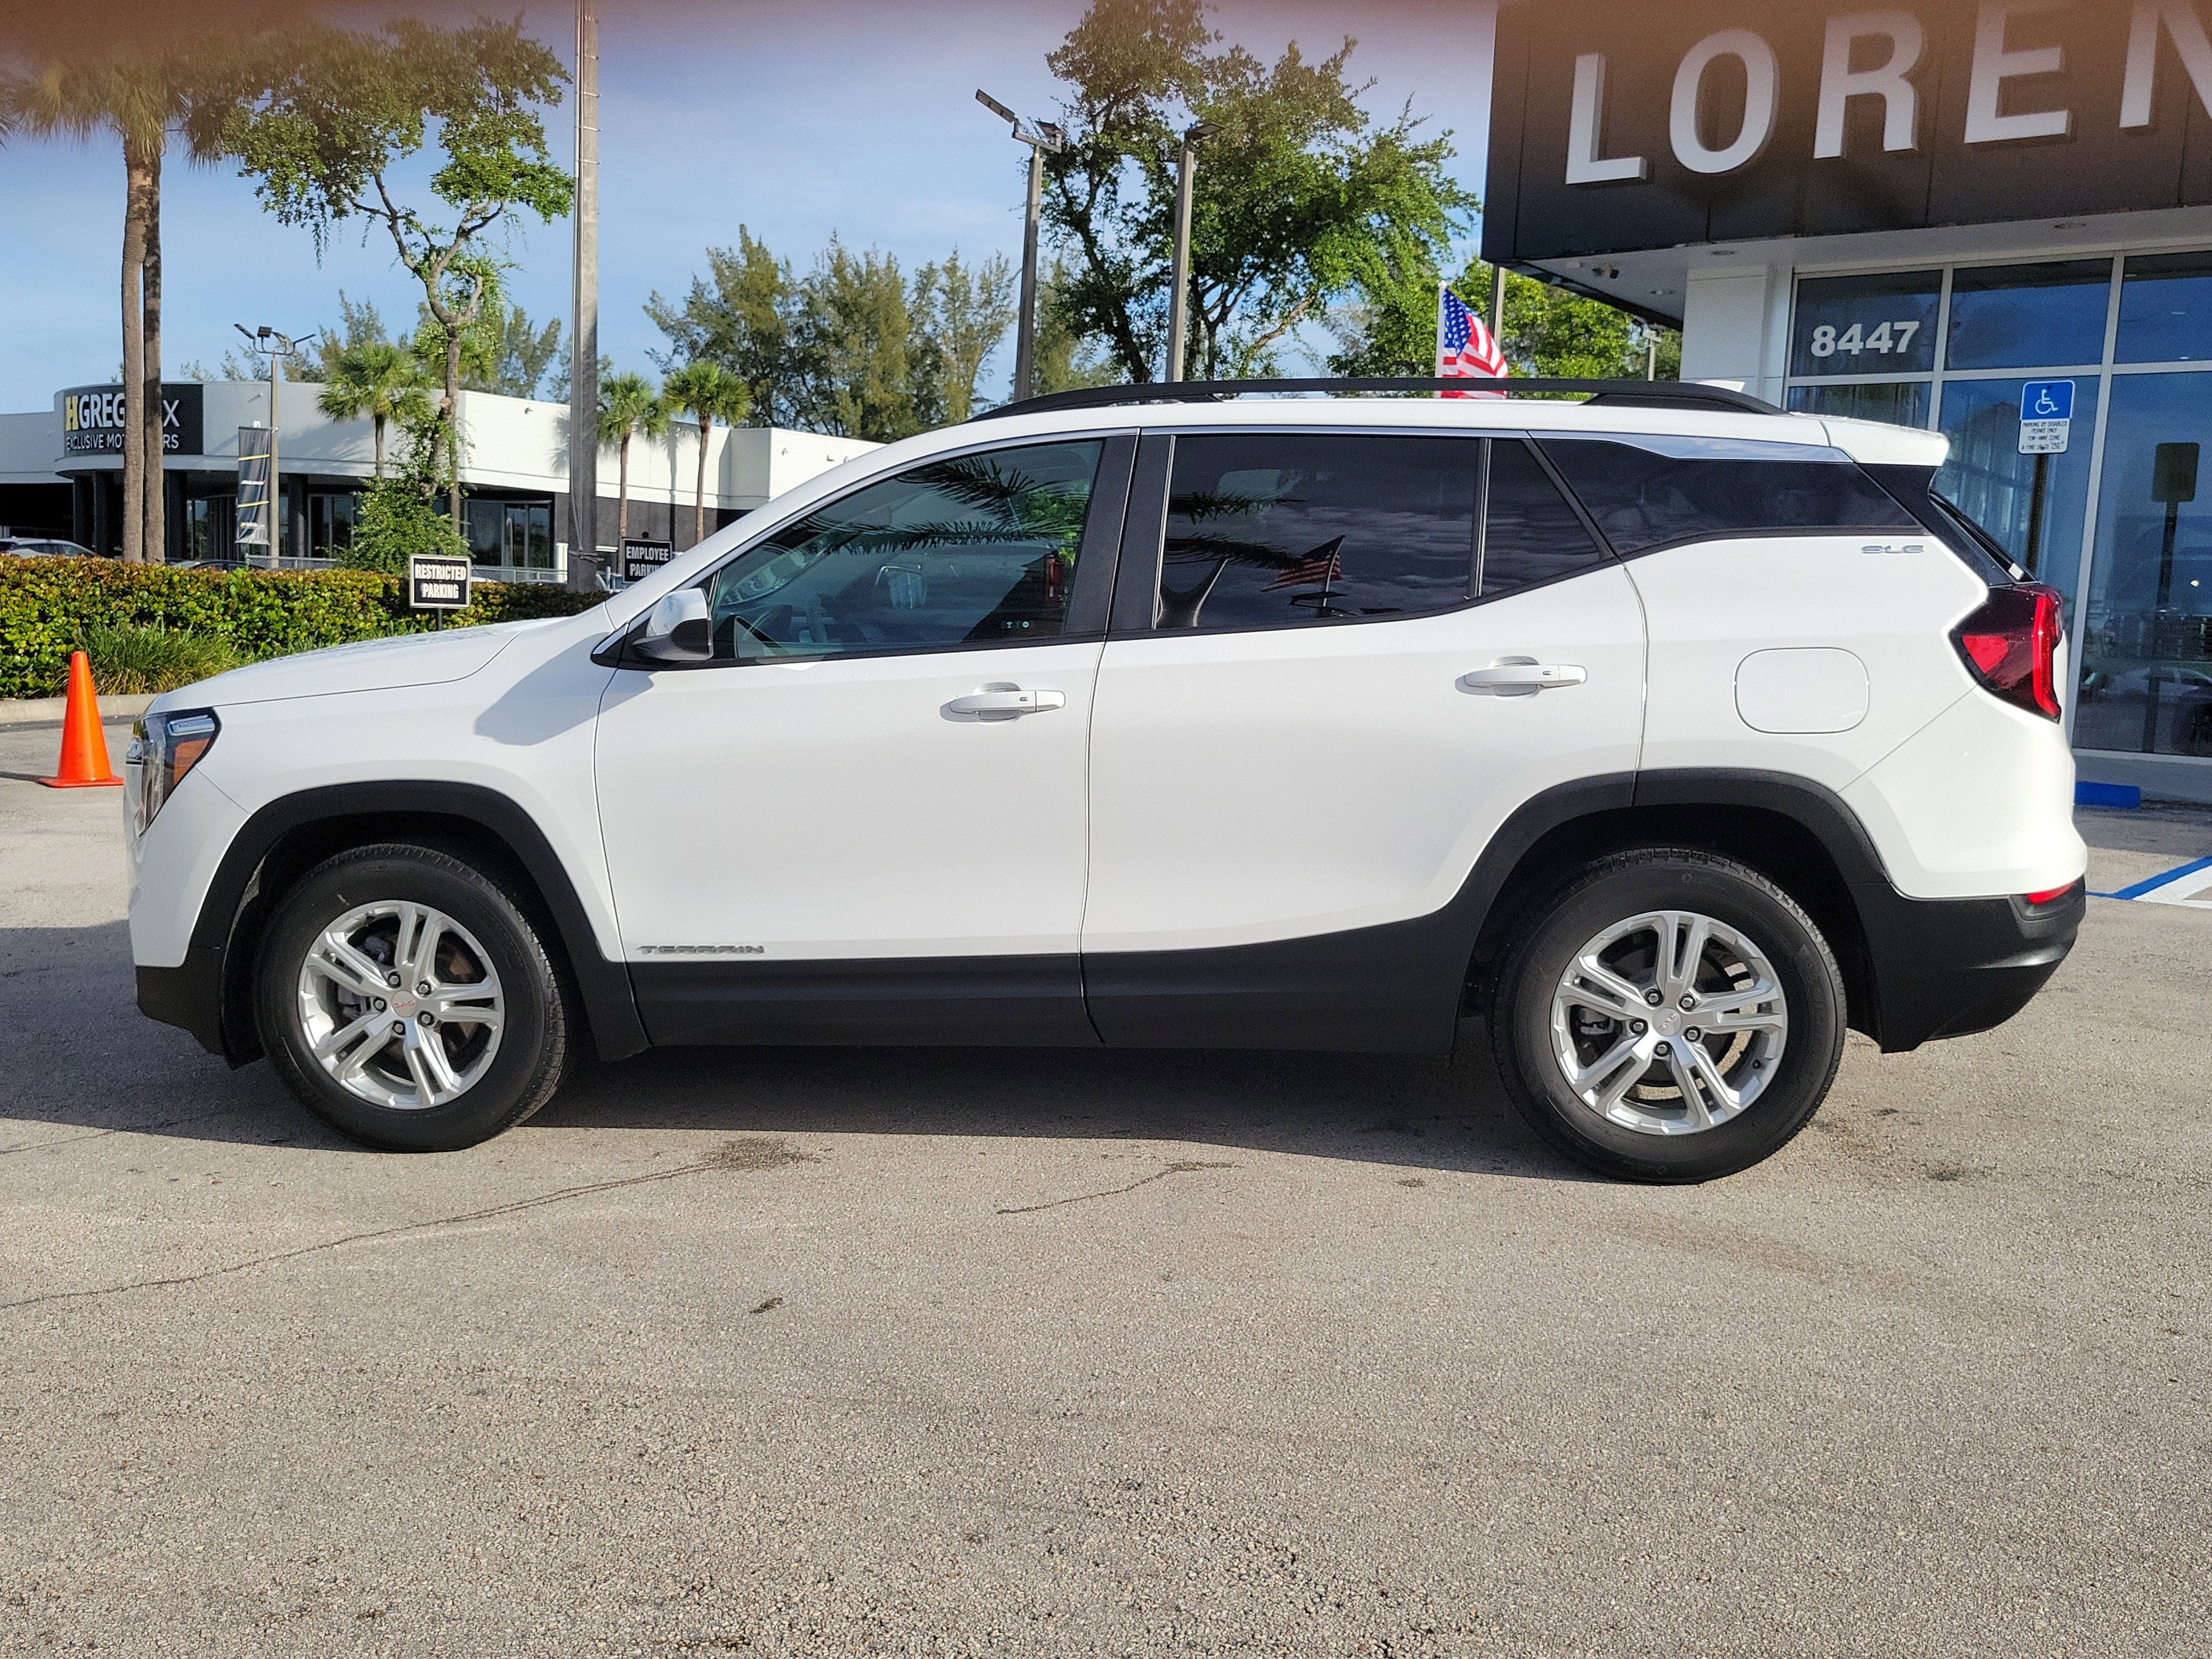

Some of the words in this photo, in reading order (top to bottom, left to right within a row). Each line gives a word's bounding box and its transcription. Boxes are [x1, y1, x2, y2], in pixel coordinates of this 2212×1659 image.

[1810, 320, 1920, 357] 8447
[65, 392, 180, 432] HGREGX
[66, 433, 104, 451] EXCLUSIVE
[625, 545, 669, 561] EMPLOYEE
[1860, 545, 1925, 554] SLE
[414, 563, 467, 581] RESTRICTED
[420, 582, 459, 599] PARKING
[635, 945, 765, 955] TERRAIN
